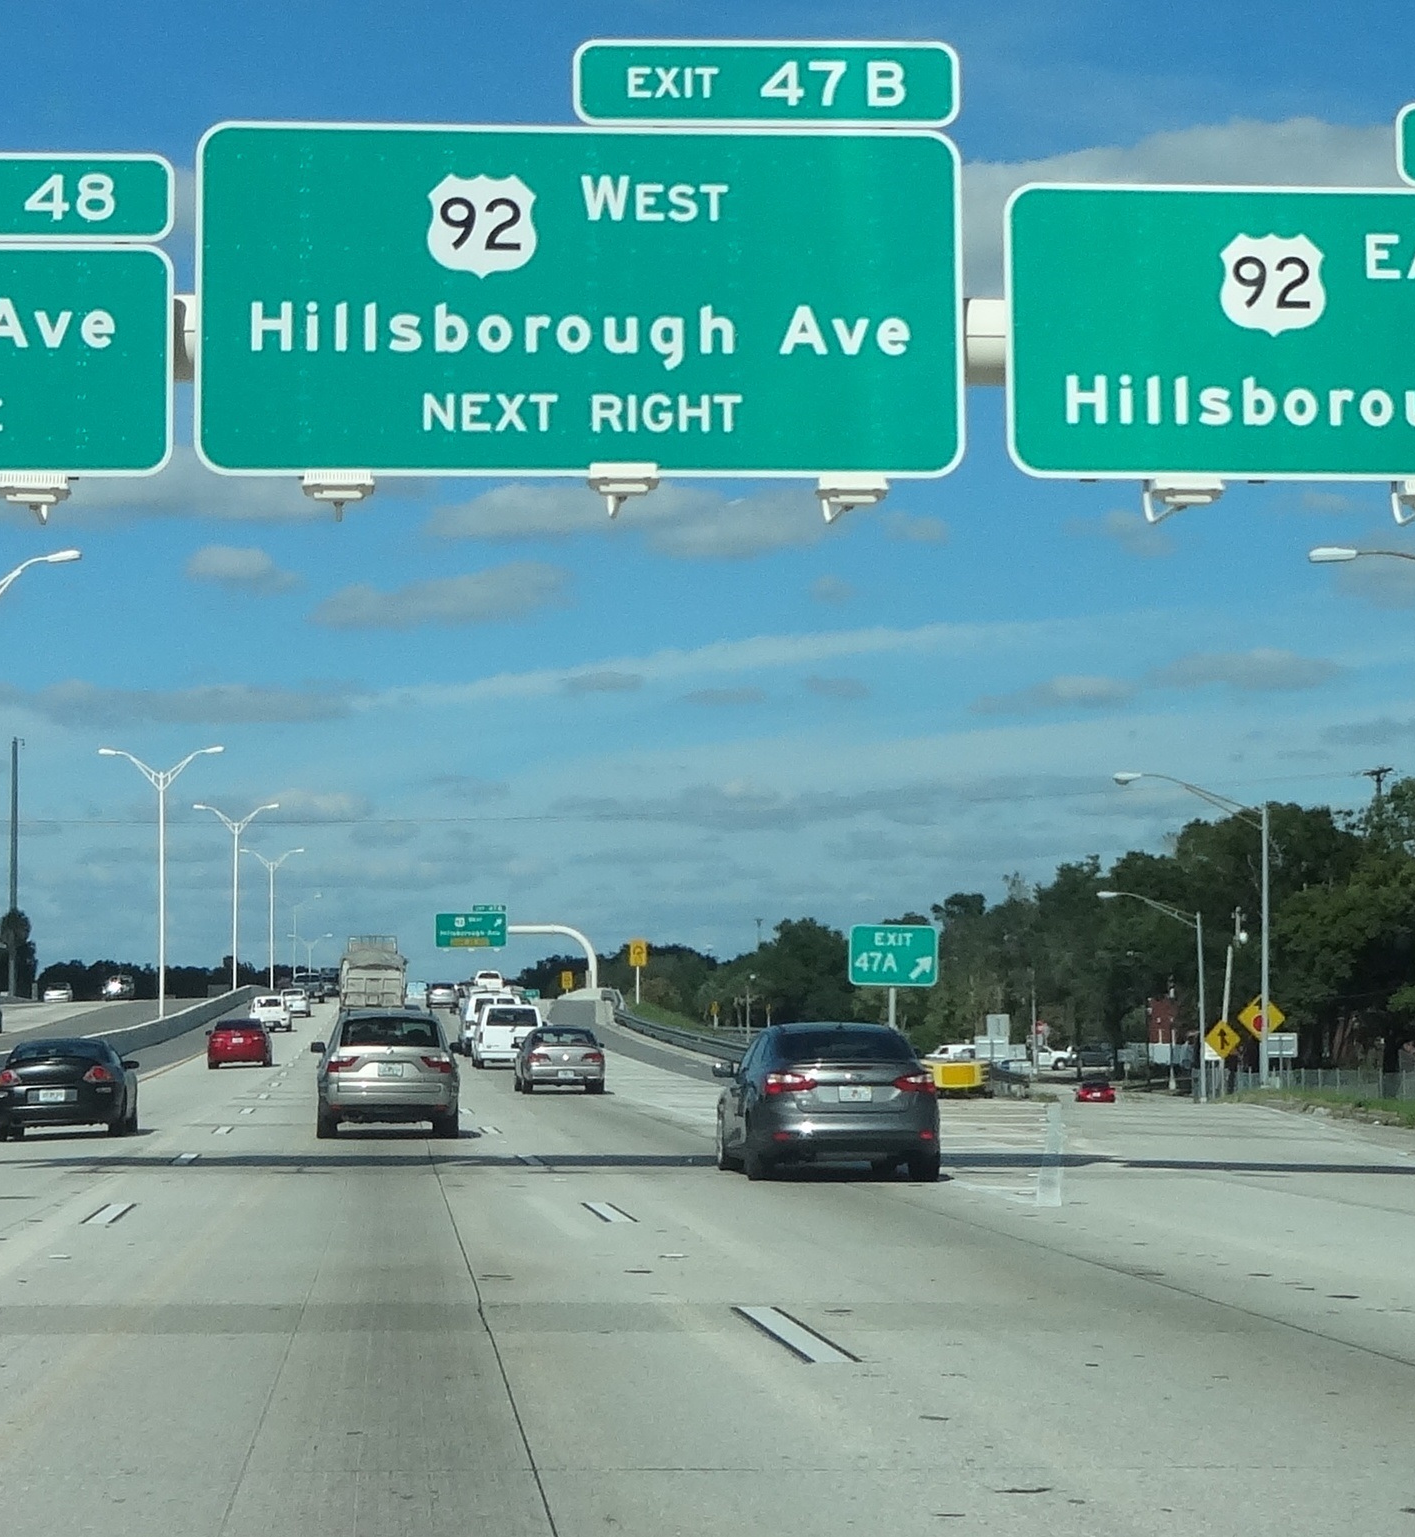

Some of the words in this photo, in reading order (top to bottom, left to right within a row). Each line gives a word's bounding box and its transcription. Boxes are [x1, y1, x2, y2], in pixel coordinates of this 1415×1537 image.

[627, 66, 719, 98] EXIT
[24, 173, 116, 223] 48
[439, 196, 521, 251] 92
[1232, 255, 1311, 309] 92
[251, 301, 735, 371] Hillsborough
[779, 305, 911, 356] Ave
[423, 393, 559, 432] NEXT
[591, 393, 743, 433] RIGHT
[854, 951, 898, 972] 47A
[873, 932, 913, 947] EXIT
